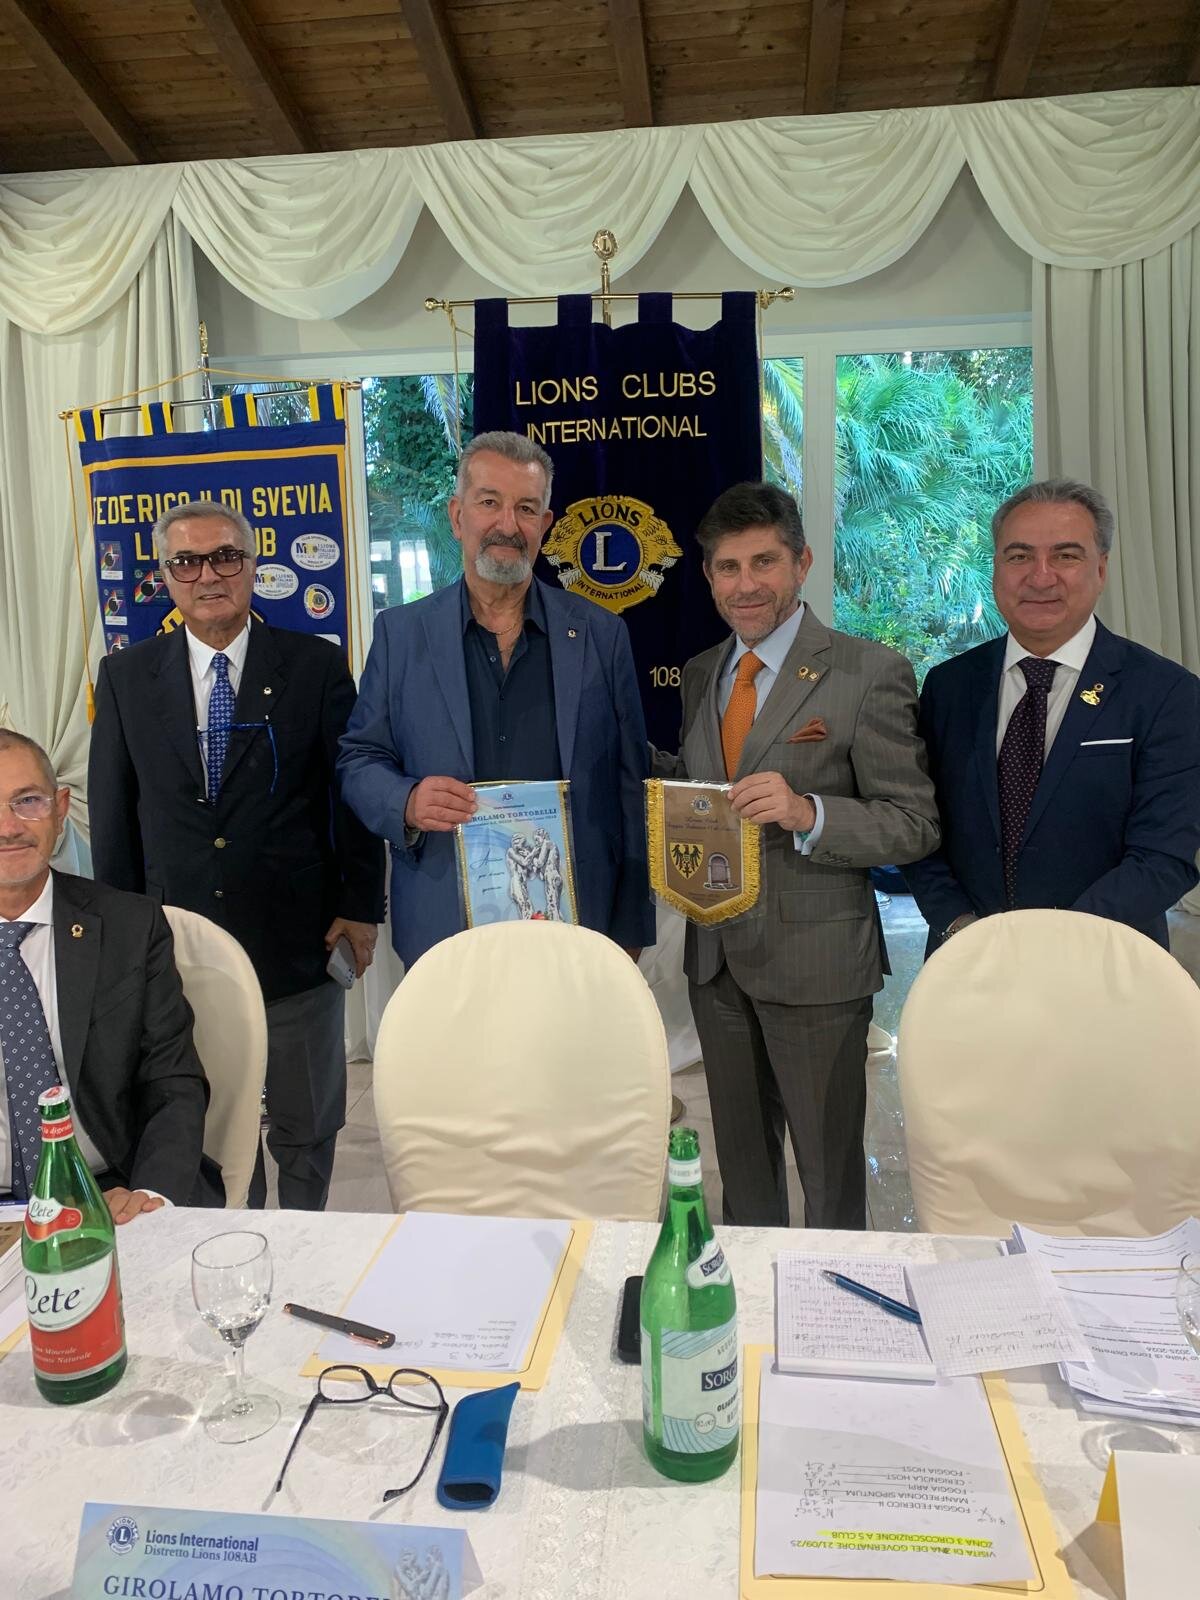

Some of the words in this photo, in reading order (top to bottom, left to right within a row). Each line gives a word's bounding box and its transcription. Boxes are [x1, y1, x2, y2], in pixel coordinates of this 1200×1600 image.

[515, 376, 599, 405] LIONS
[622, 371, 716, 399] CLUBS
[527, 415, 707, 445] INTERNATIONAL
[93, 491, 190, 525] EDERIC
[252, 482, 333, 517] SVEVIA
[578, 503, 643, 527] LIONS
[255, 527, 276, 557] UB
[592, 531, 627, 571] L
[576, 580, 645, 600] INTERNATIONAL
[649, 666, 681, 688] 108
[471, 813, 505, 822] ROLAMO
[29, 1201, 54, 1218] Lete
[25, 1275, 81, 1315] Lete
[902, 1465, 926, 1473] HOST
[927, 1467, 963, 1477] FOGGIA
[912, 1475, 965, 1486] CERIGNOLA
[908, 1484, 929, 1492] ARPI
[929, 1486, 967, 1495] FOGGIA
[845, 1490, 895, 1499] SIPONTUM
[896, 1492, 969, 1505] MANFREDONIA
[886, 1501, 932, 1510] FEDERICO
[934, 1504, 970, 1514] FOGGIA
[146, 1530, 177, 1545] Lions
[179, 1532, 259, 1551] International
[831, 1531, 856, 1539] CLUB
[876, 1533, 955, 1545] CIRCOSCRIZIONE
[790, 1540, 834, 1549] 21/09/25
[836, 1541, 908, 1552] GOVERNATORE
[911, 1545, 928, 1553] DEL
[966, 1539, 993, 1549] ZONA
[144, 1545, 189, 1558] Distretto
[192, 1550, 221, 1561] Lions
[223, 1551, 257, 1564] 108AB
[966, 1549, 996, 1558] VISITA
[103, 1575, 244, 1600] GIROLAMO
